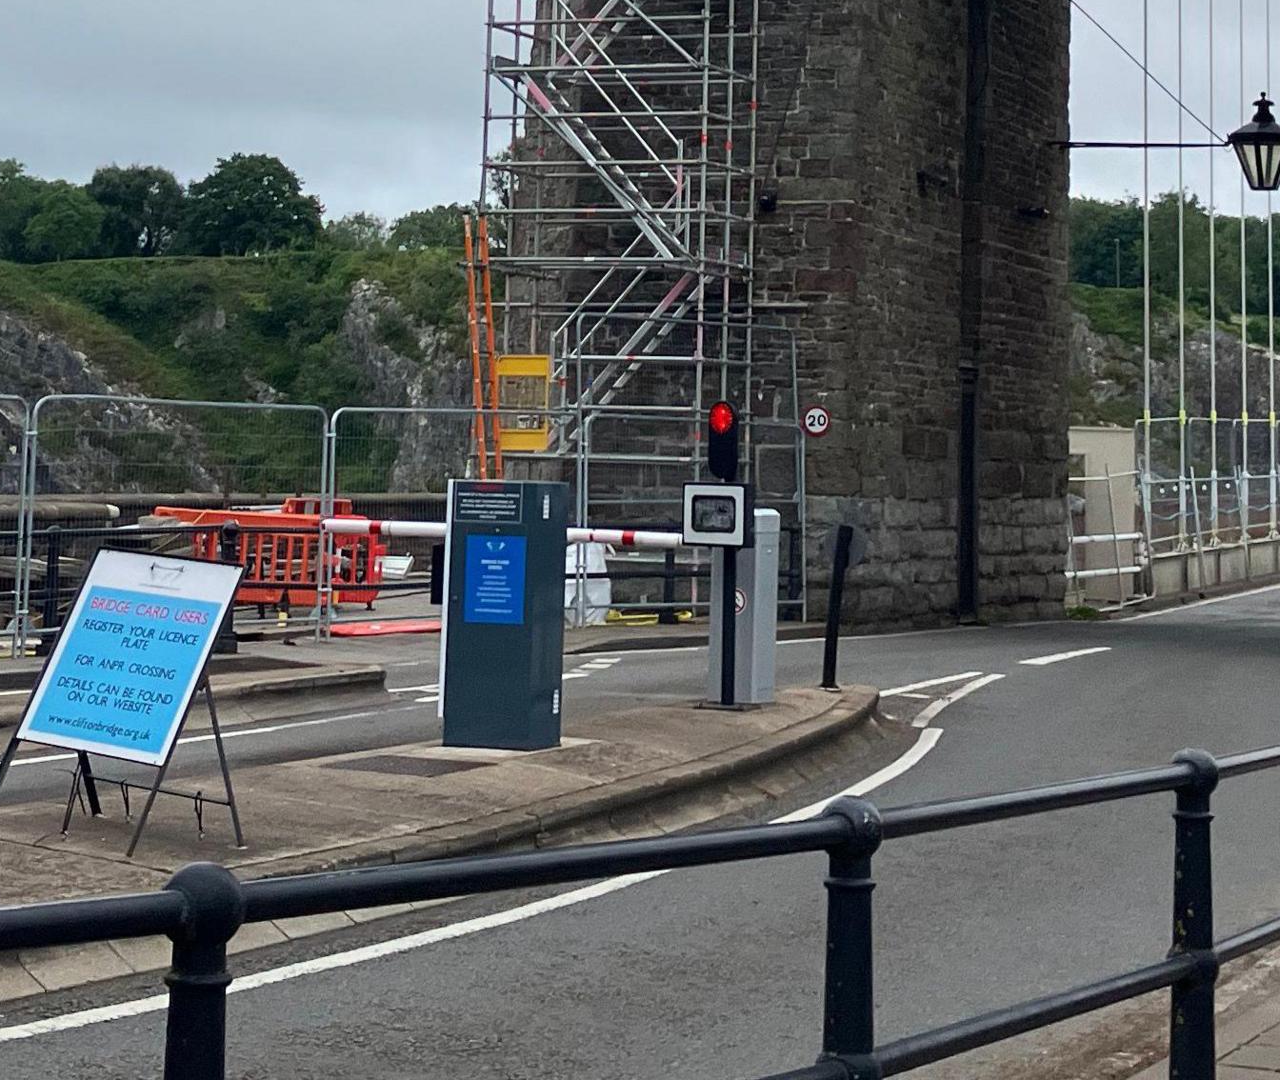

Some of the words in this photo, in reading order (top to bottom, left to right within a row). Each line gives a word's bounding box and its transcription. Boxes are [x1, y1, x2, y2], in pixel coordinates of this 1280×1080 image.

[808, 415, 827, 426] 20
[90, 596, 130, 614] BRIDGE
[135, 603, 170, 619] CARD
[174, 609, 209, 625] USERS
[82, 618, 124, 634] REGISTER
[129, 626, 155, 640] YOUR
[158, 630, 199, 646] LICENCE
[120, 638, 150, 651] PLATE
[74, 654, 94, 666] FOR
[99, 658, 124, 671] ANPR
[128, 662, 177, 681] CROSSING
[56, 676, 93, 692] DETAILS
[96, 682, 120, 697] CAN
[122, 686, 135, 698] BE
[137, 689, 173, 705] FOUND
[67, 691, 84, 703] ON
[87, 695, 109, 708] OUR
[113, 699, 154, 715] WEBSITE
[47, 713, 151, 742] www.cliftonbridge.org.uk
